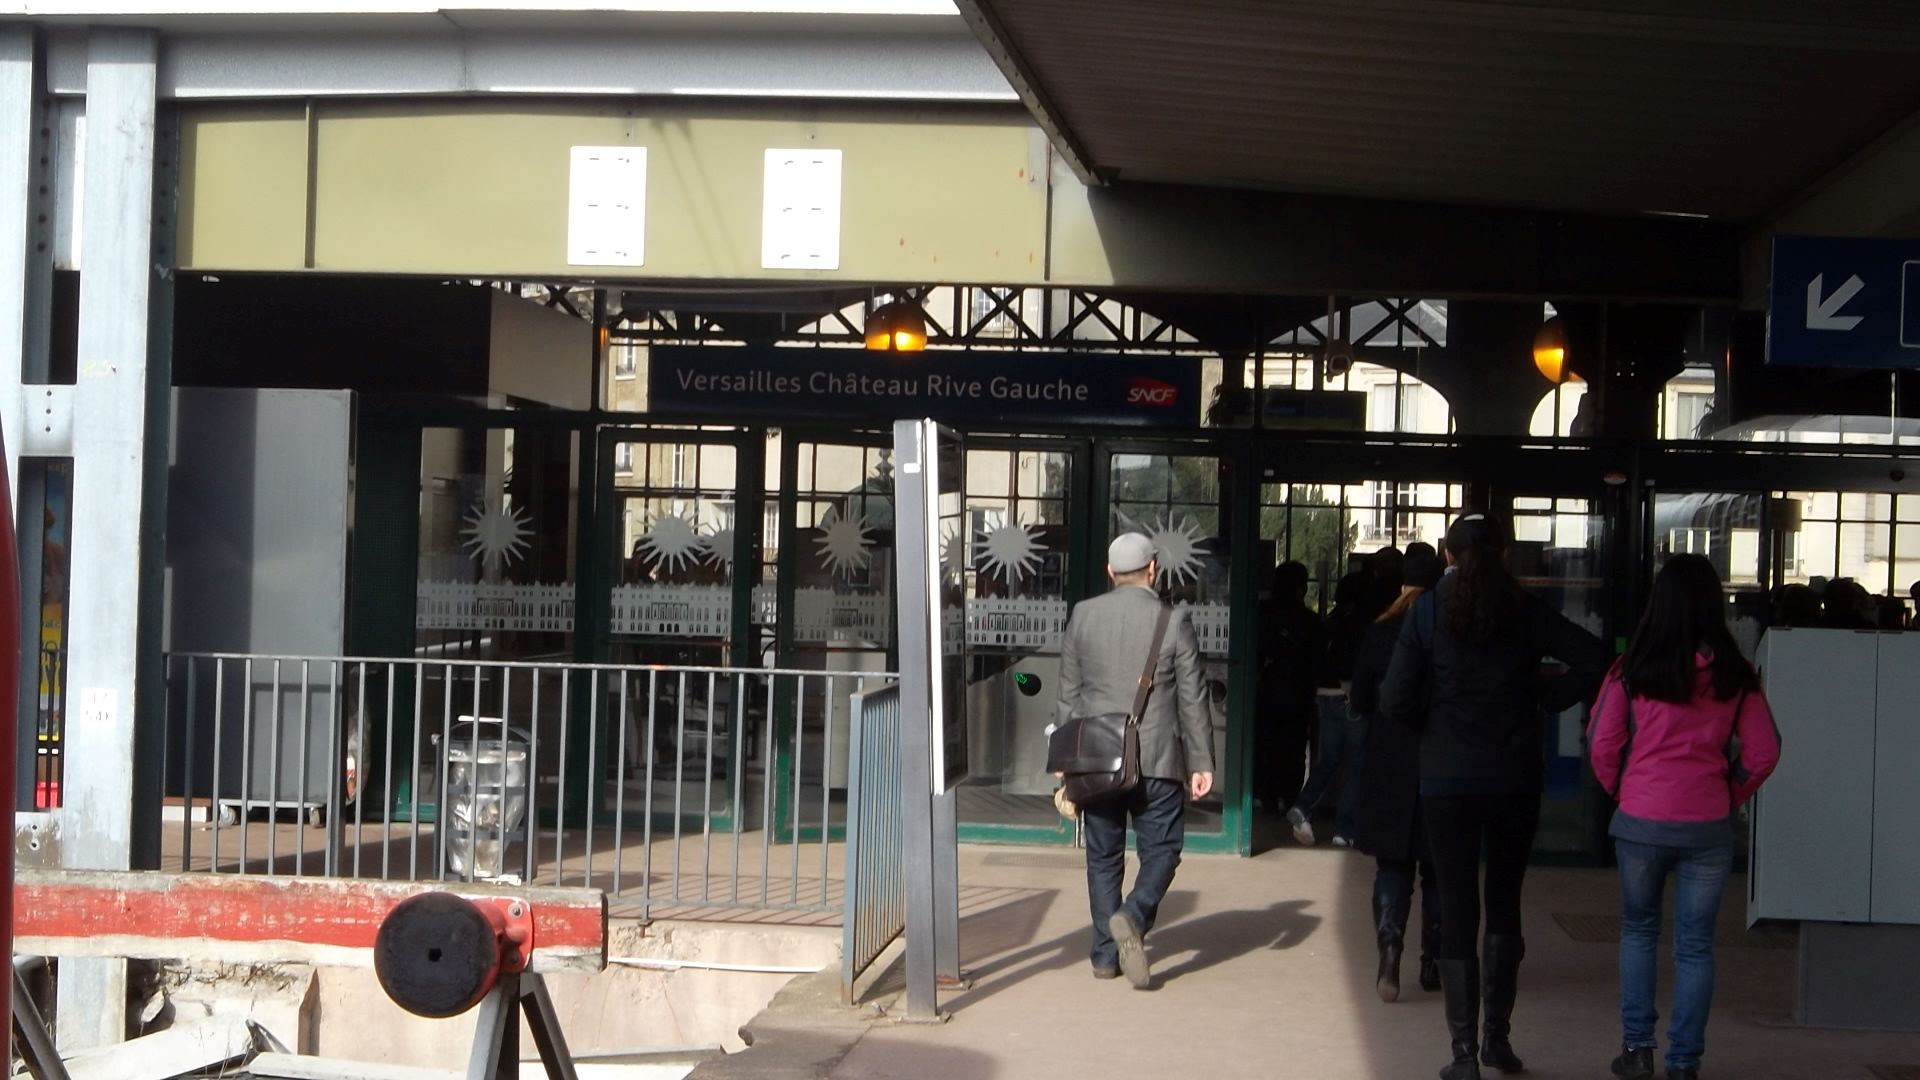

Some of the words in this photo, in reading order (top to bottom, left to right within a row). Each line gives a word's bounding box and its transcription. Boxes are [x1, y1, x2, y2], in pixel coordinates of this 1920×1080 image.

[676, 368, 801, 393] Versailles
[809, 370, 918, 396] Château
[928, 374, 982, 398] Rive
[990, 376, 1089, 401] Gauche
[1127, 386, 1176, 403] SNCF
